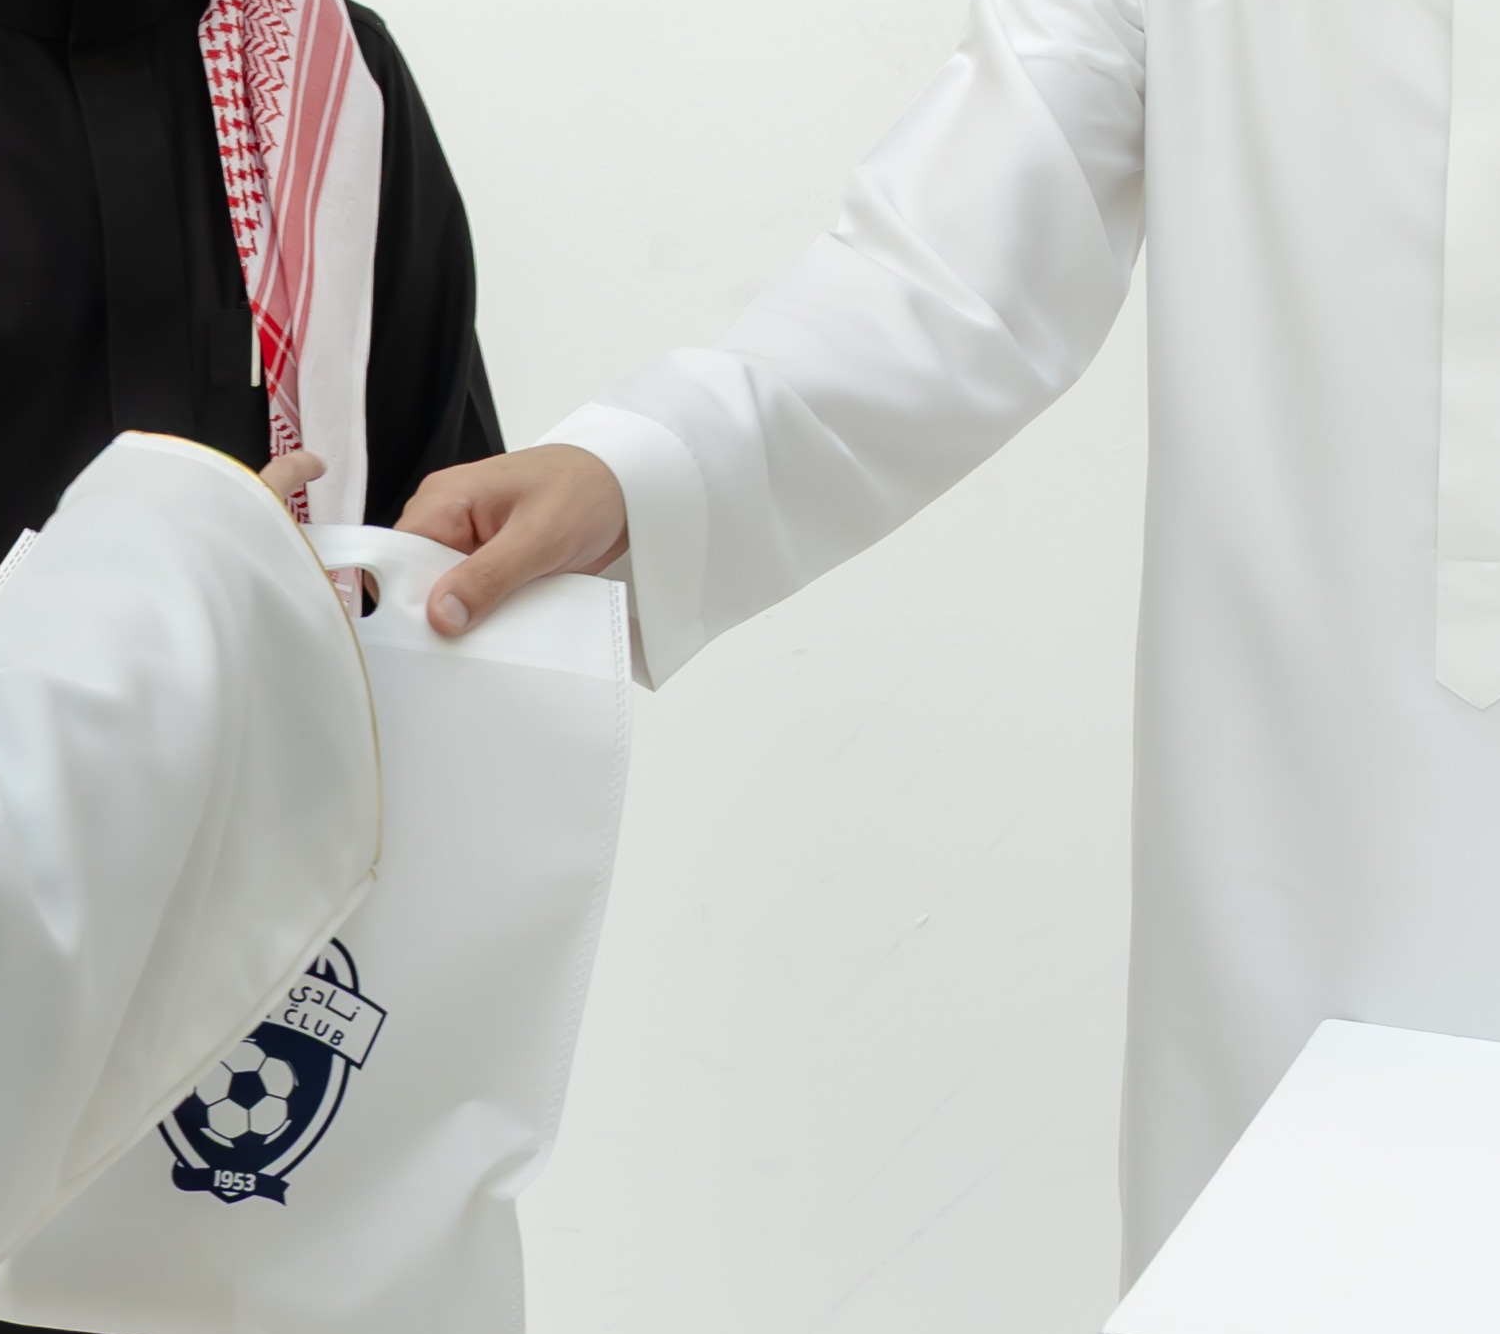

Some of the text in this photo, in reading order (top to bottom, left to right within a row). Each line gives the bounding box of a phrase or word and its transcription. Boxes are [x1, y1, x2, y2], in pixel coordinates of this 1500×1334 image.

[288, 986, 361, 1022] نادي
[283, 1008, 345, 1046] CLUB
[213, 1169, 257, 1192] 1953
